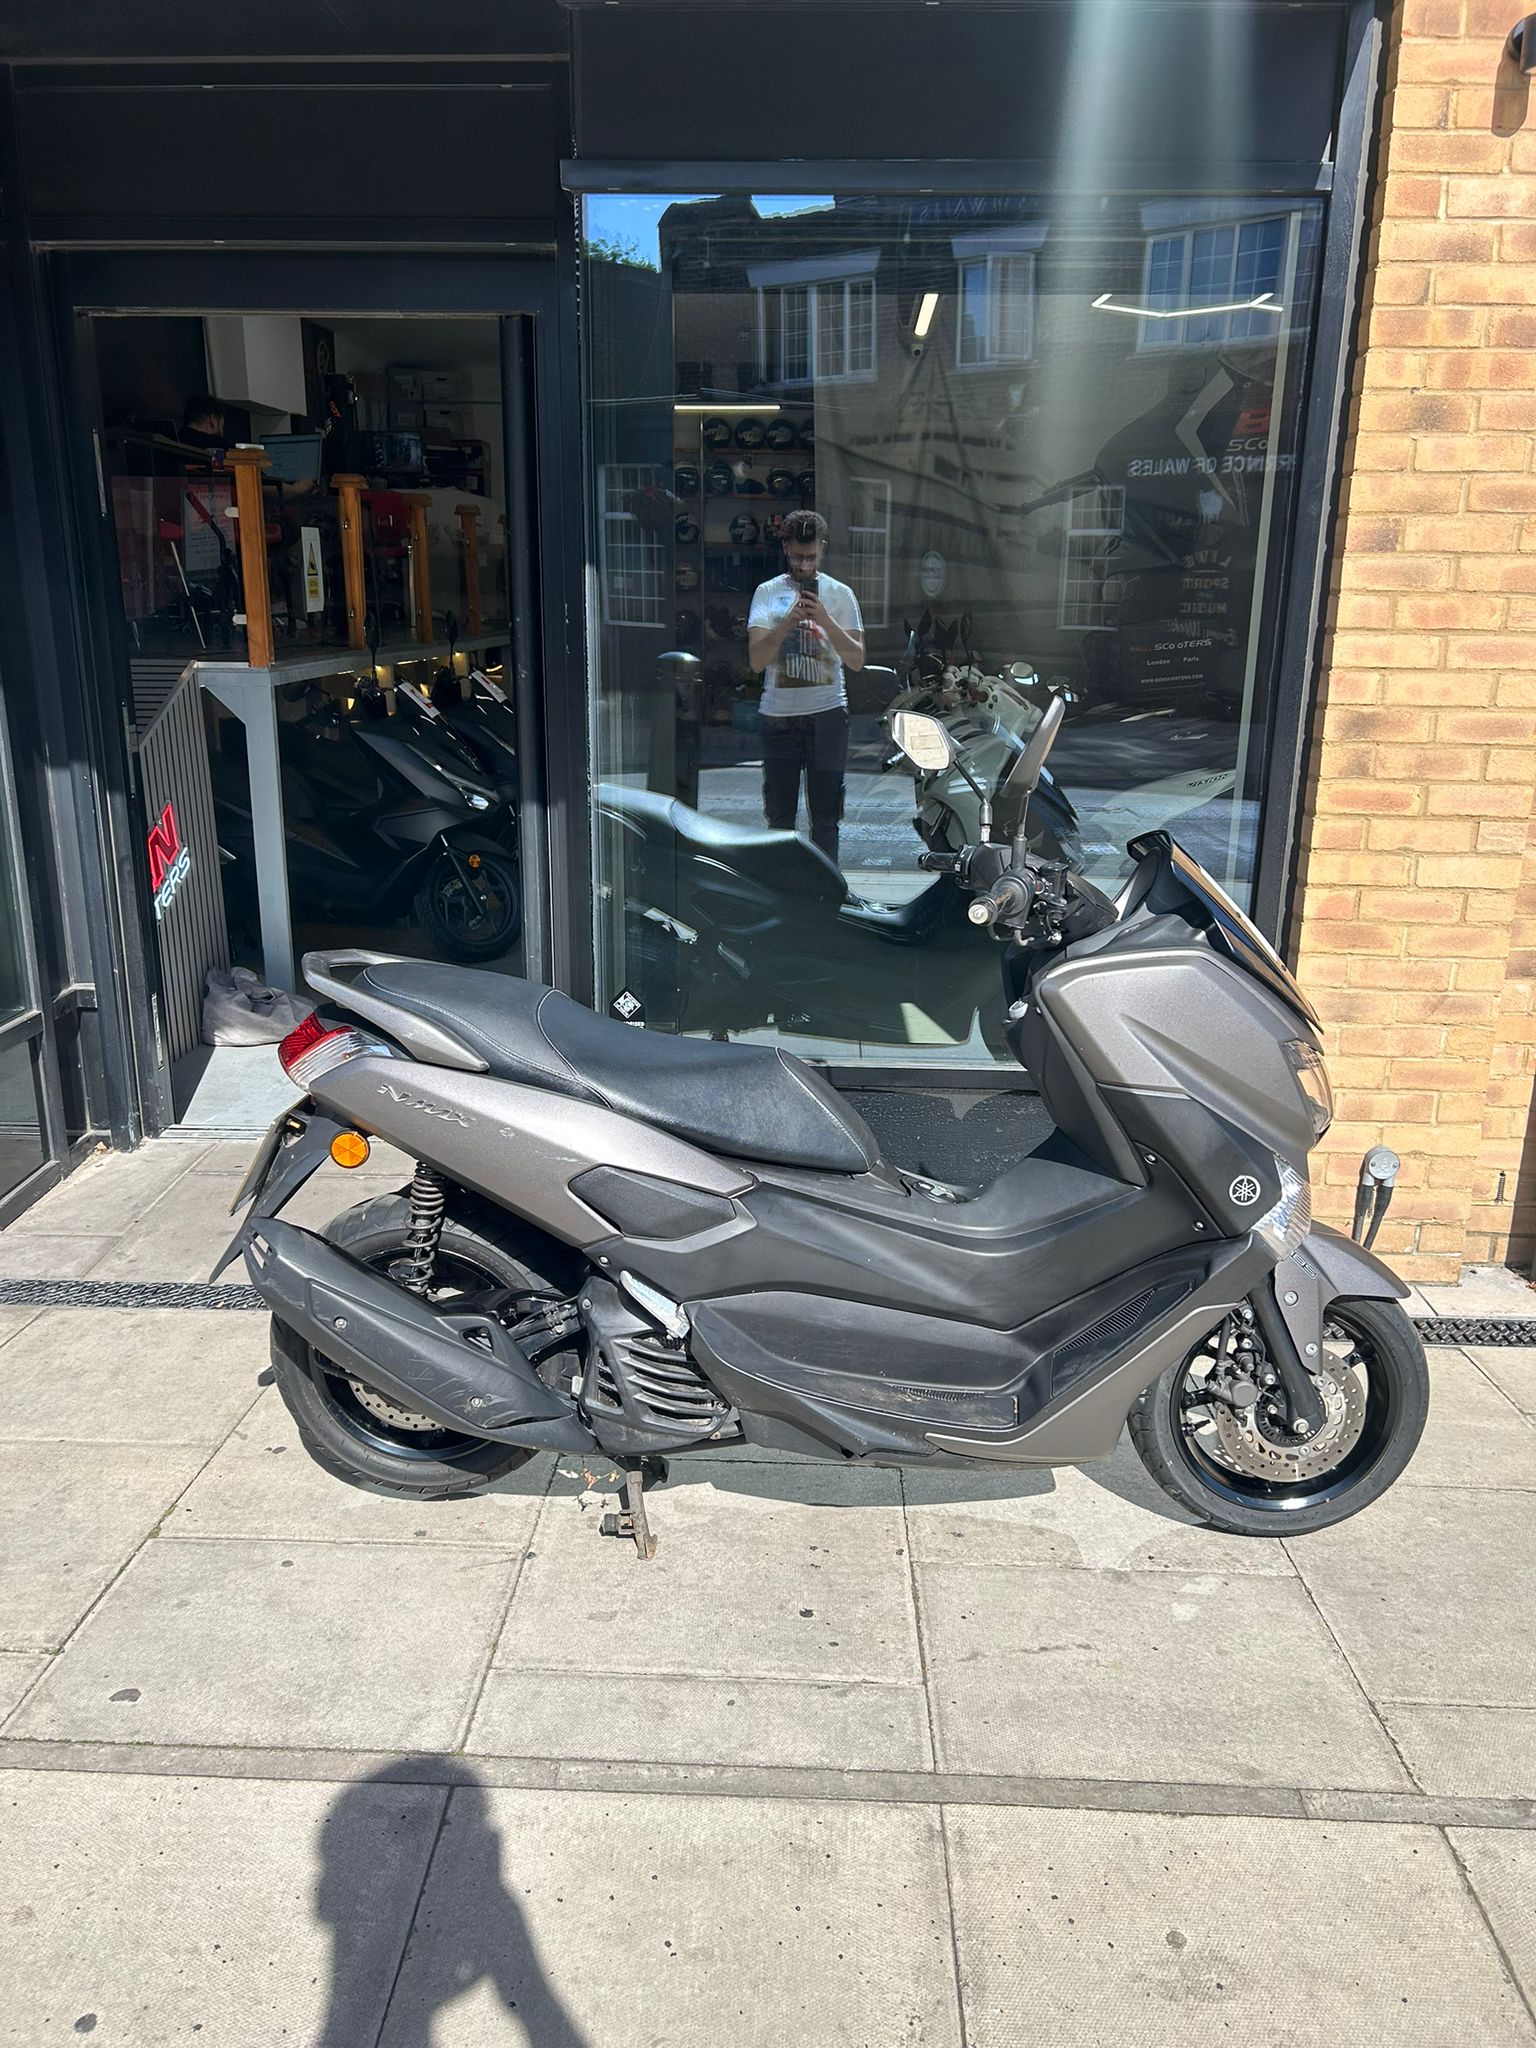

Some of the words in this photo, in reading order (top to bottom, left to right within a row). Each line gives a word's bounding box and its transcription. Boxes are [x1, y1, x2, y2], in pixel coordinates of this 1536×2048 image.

[1146, 658, 1171, 666] London
[1182, 656, 1200, 664] Paris
[376, 1083, 477, 1129] NMAX
